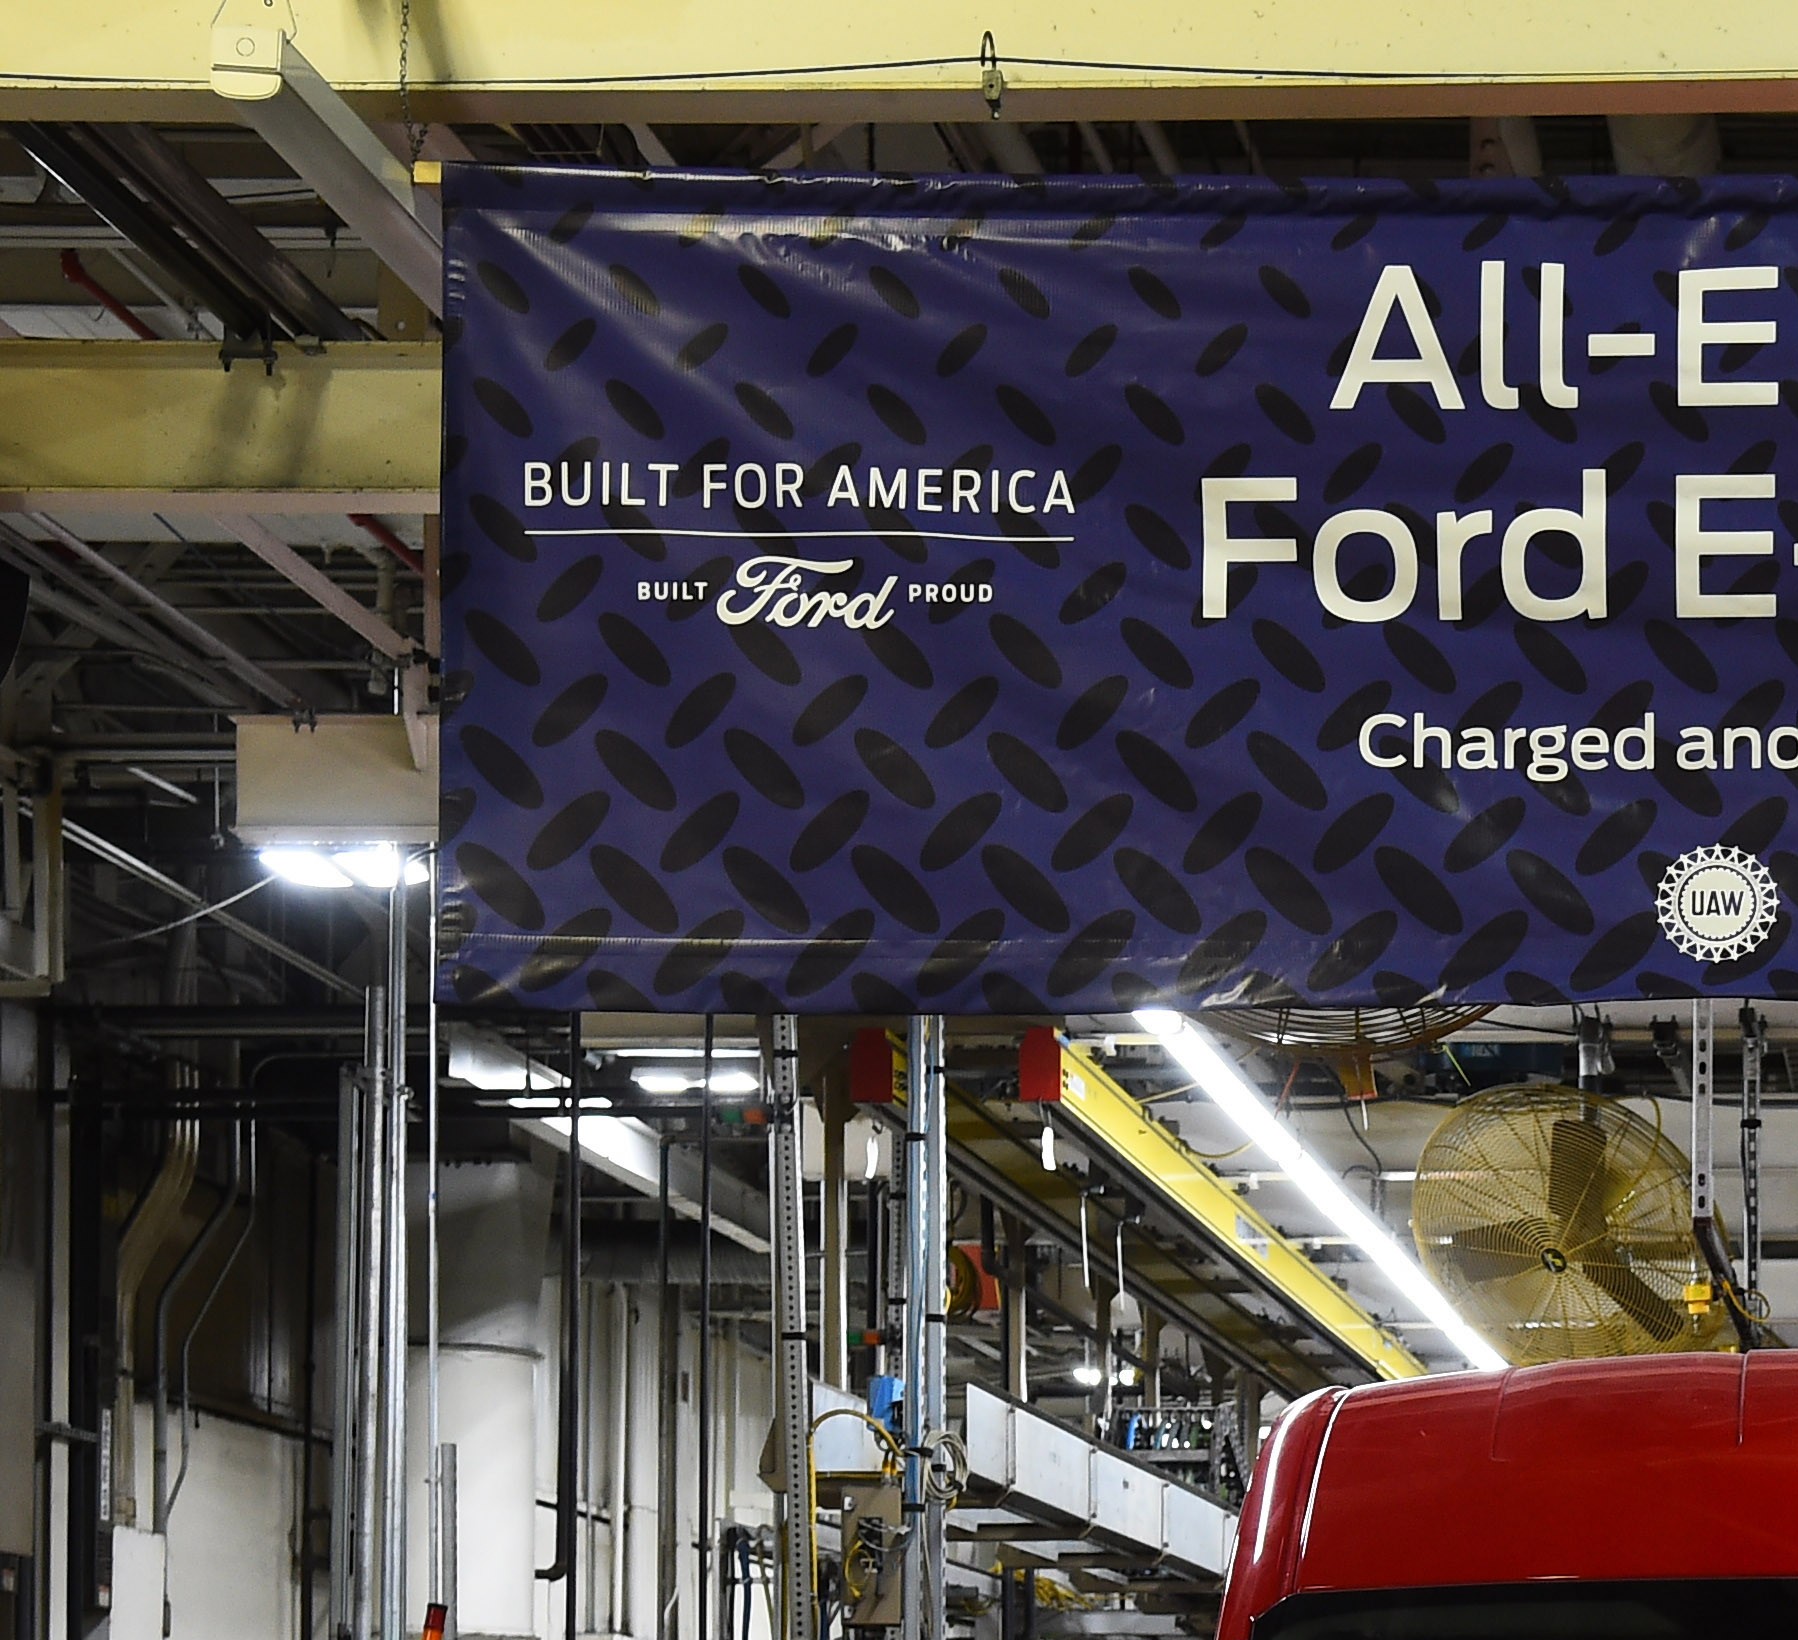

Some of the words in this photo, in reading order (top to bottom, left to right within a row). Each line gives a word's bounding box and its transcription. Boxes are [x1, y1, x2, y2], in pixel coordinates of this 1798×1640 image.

[524, 461, 679, 507] BUILT
[703, 462, 804, 509] FOR
[827, 464, 1075, 514] AMERICA
[1201, 468, 1607, 623] Ford
[637, 581, 708, 601] BUILT
[716, 555, 899, 630] Ford
[908, 583, 993, 603] PROUD
[1358, 711, 1655, 782] Charged
[1690, 890, 1745, 917] UAW
